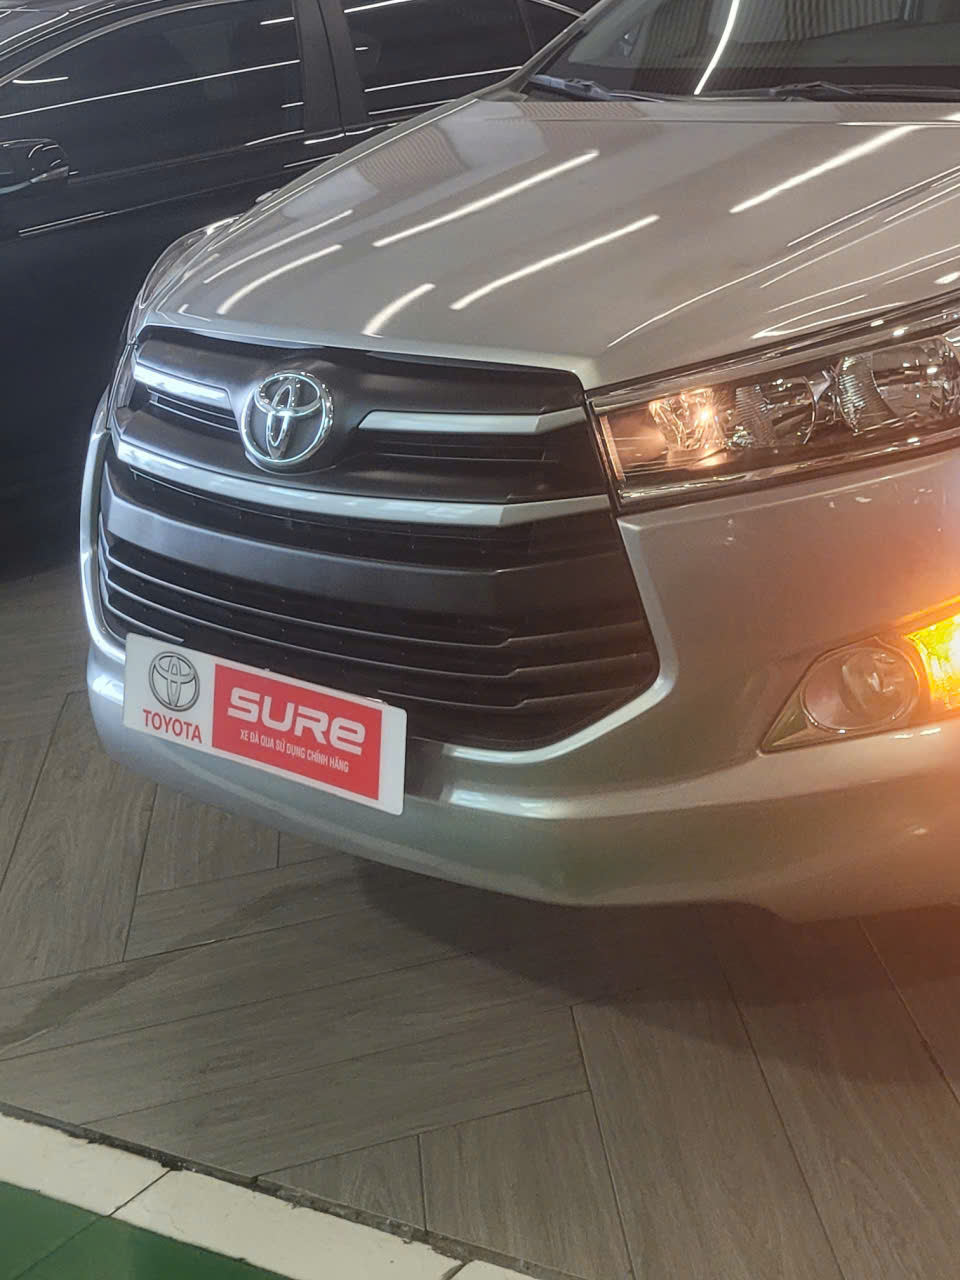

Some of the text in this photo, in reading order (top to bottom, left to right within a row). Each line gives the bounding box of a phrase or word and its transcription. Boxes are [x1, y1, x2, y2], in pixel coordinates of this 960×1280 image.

[142, 708, 203, 745] TOYOTA
[240, 729, 249, 741] XE
[260, 735, 275, 750] QUA
